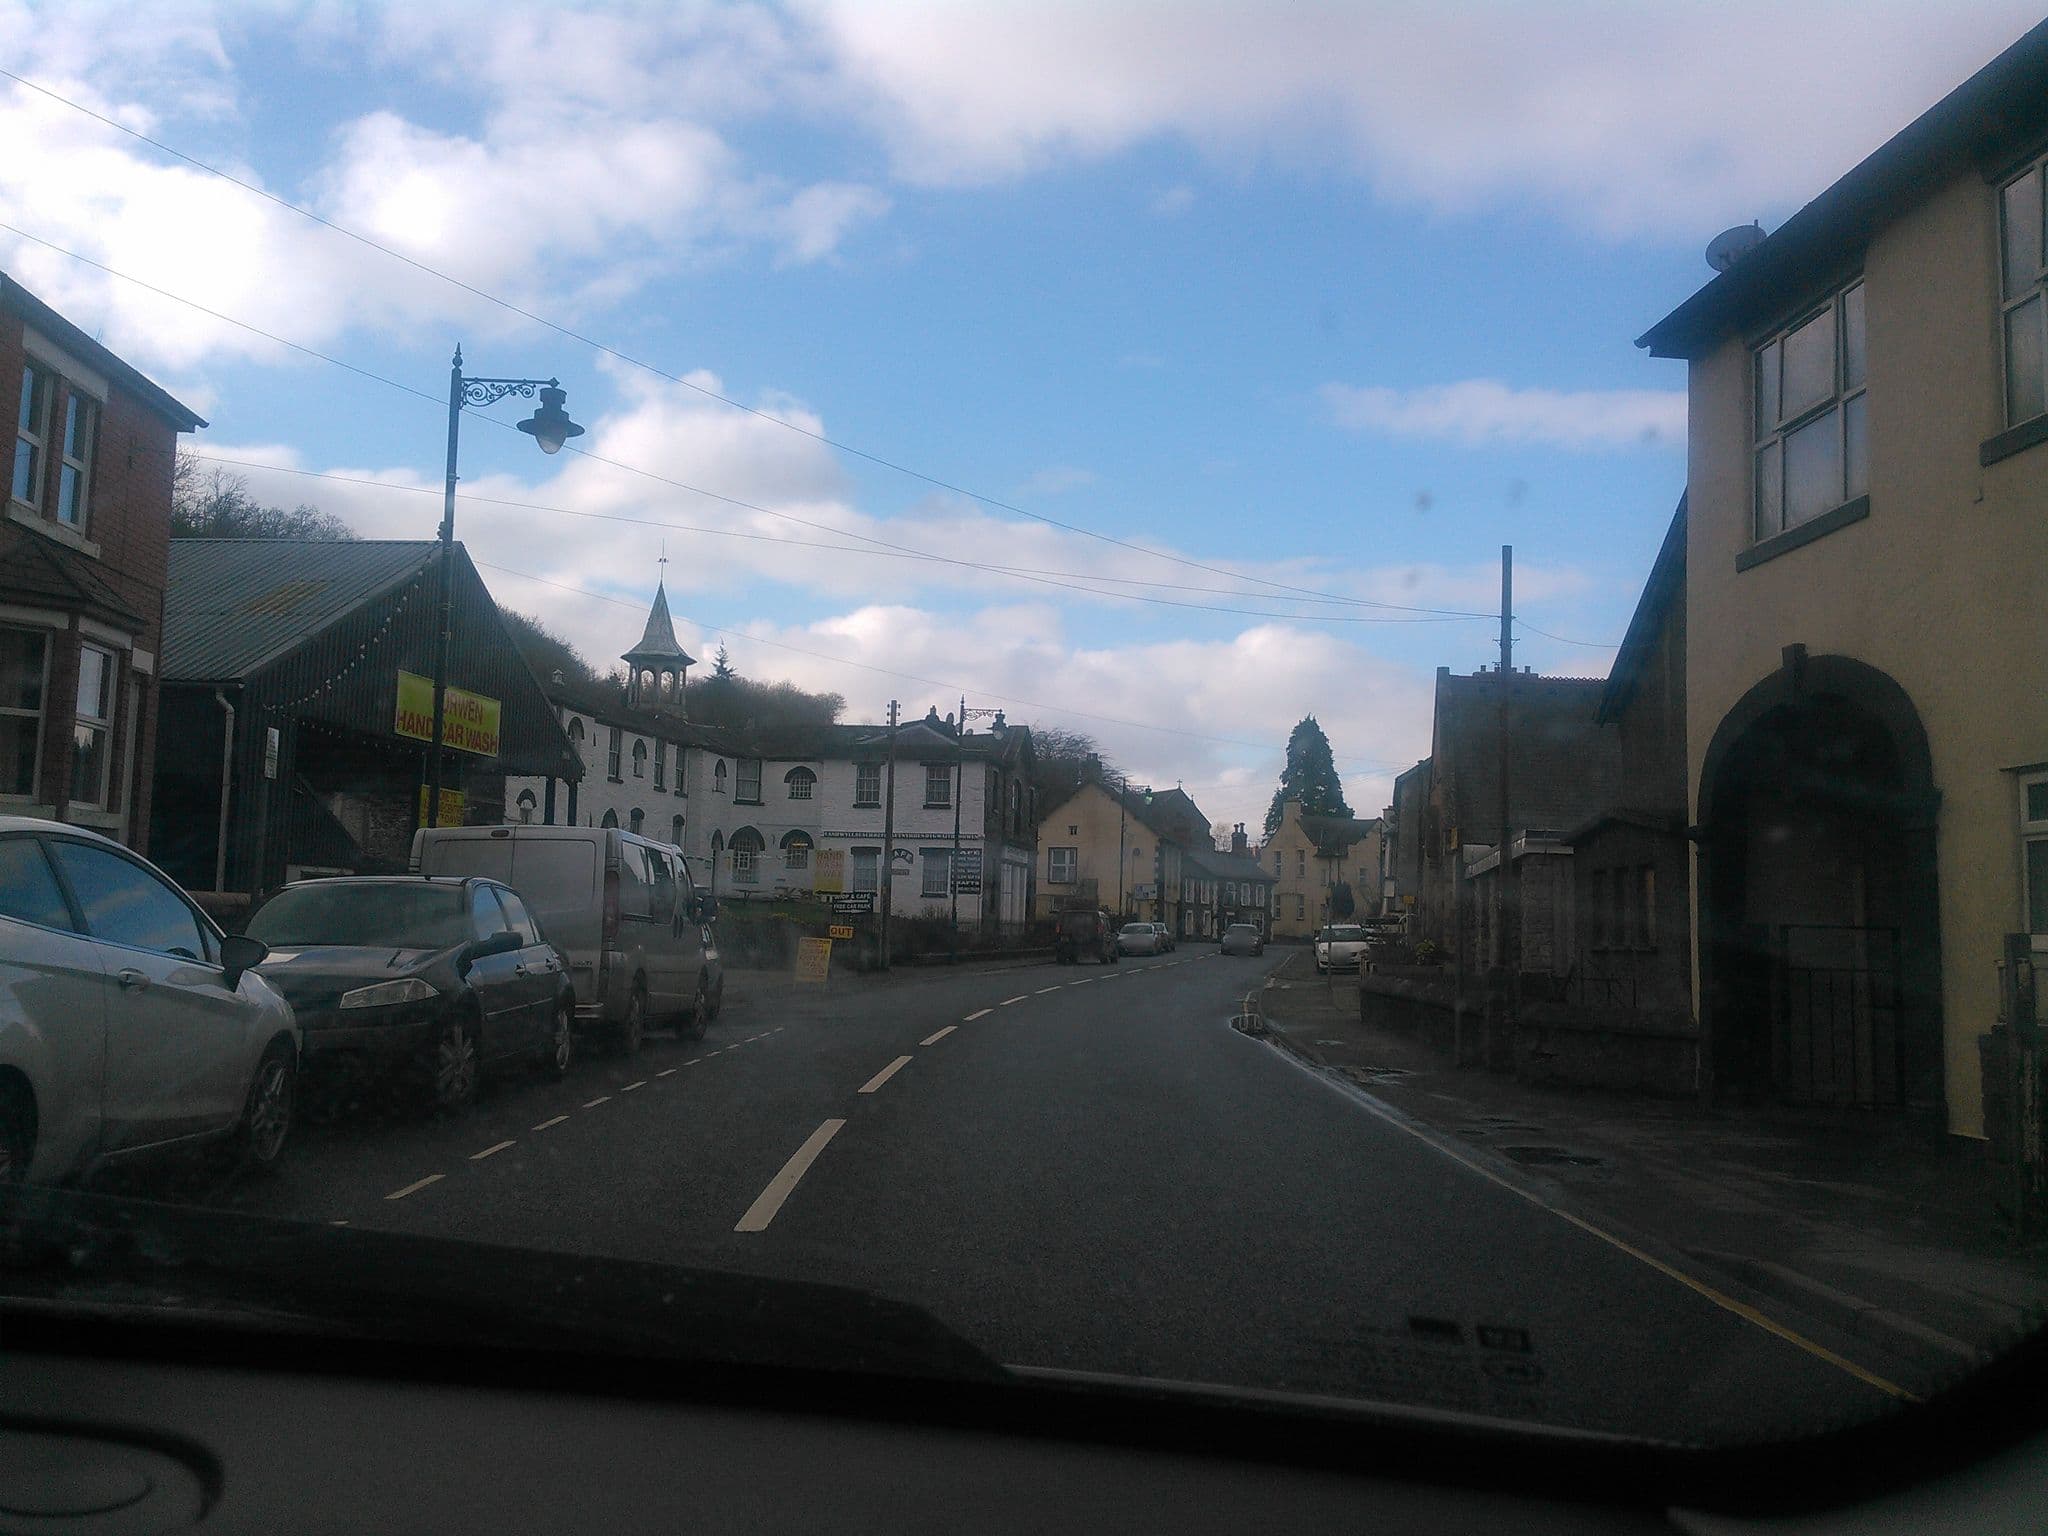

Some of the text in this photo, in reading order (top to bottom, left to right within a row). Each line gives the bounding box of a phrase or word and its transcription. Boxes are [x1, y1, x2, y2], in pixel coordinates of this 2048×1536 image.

[397, 710, 434, 738] HAND
[464, 726, 499, 753] WASH
[830, 926, 852, 937] OUT
